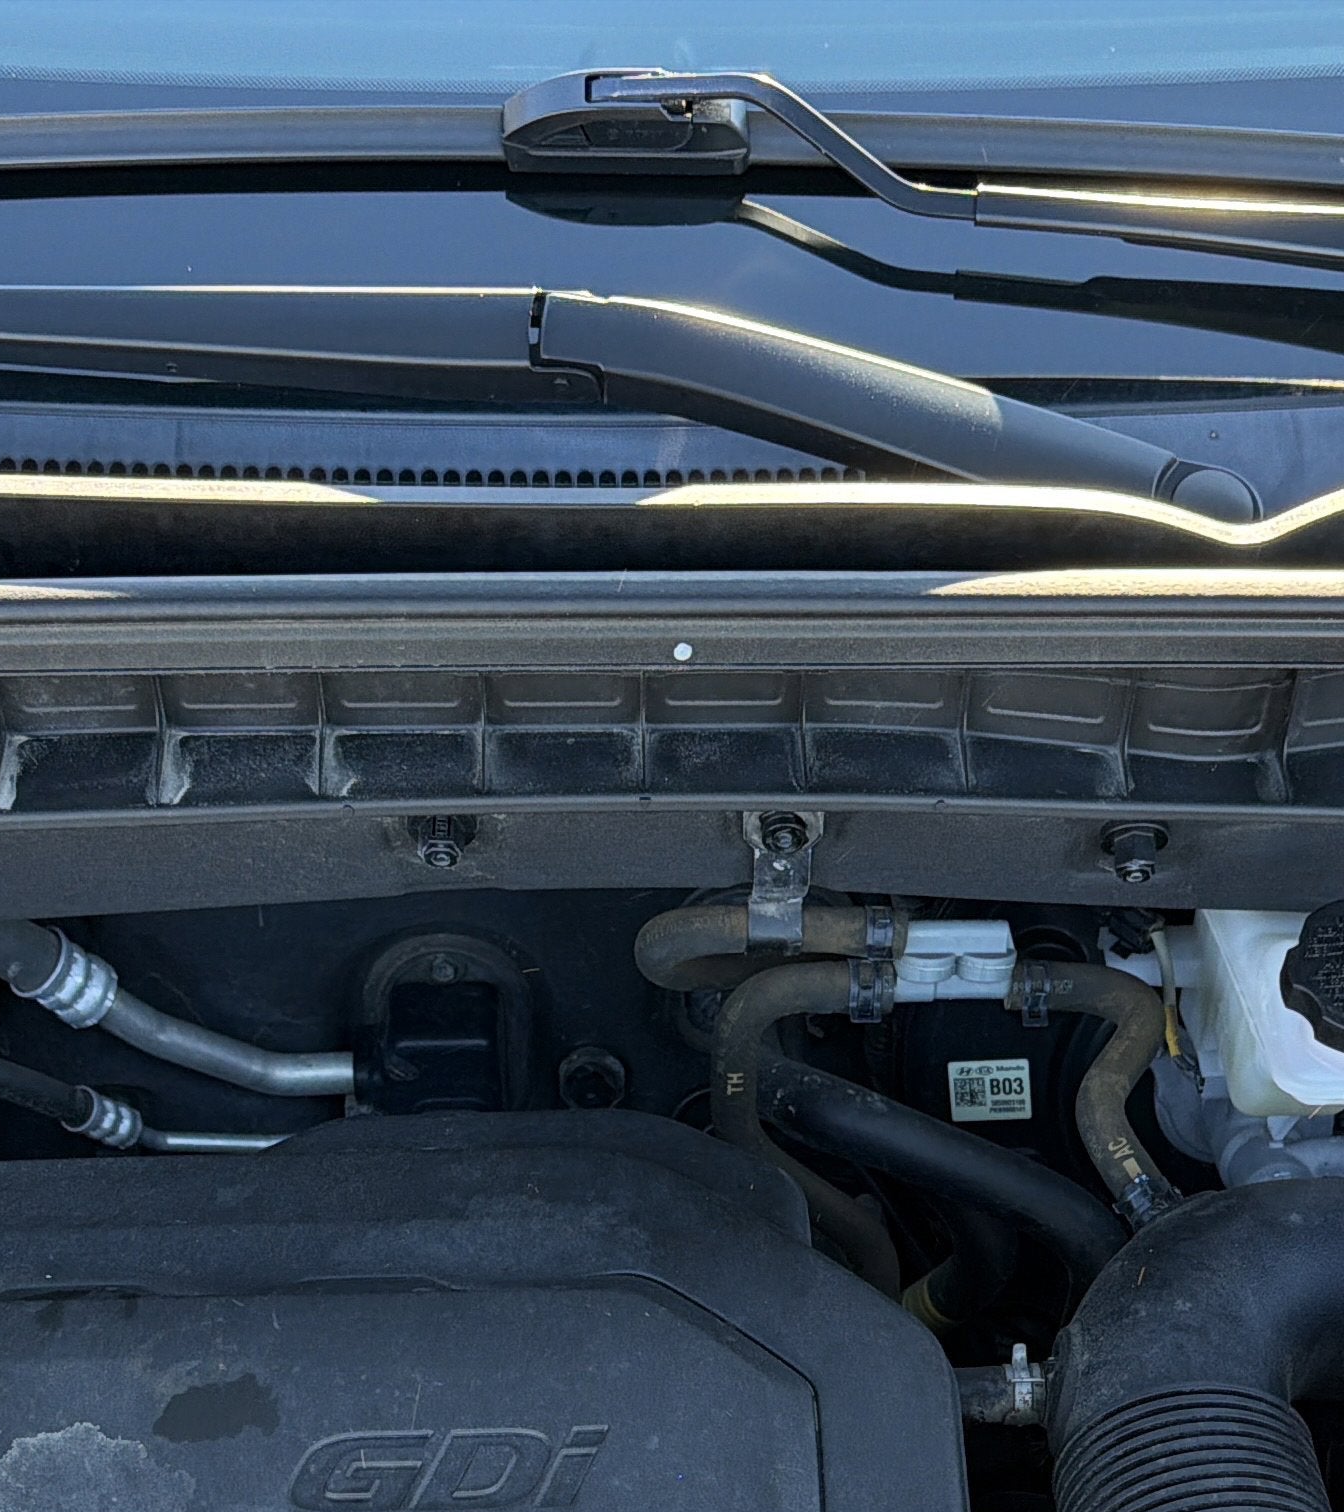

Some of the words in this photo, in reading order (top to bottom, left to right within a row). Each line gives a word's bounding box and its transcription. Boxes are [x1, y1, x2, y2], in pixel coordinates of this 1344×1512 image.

[726, 1072, 744, 1095] TH
[989, 1077, 1025, 1096] B03
[287, 1424, 609, 1512] GDi
